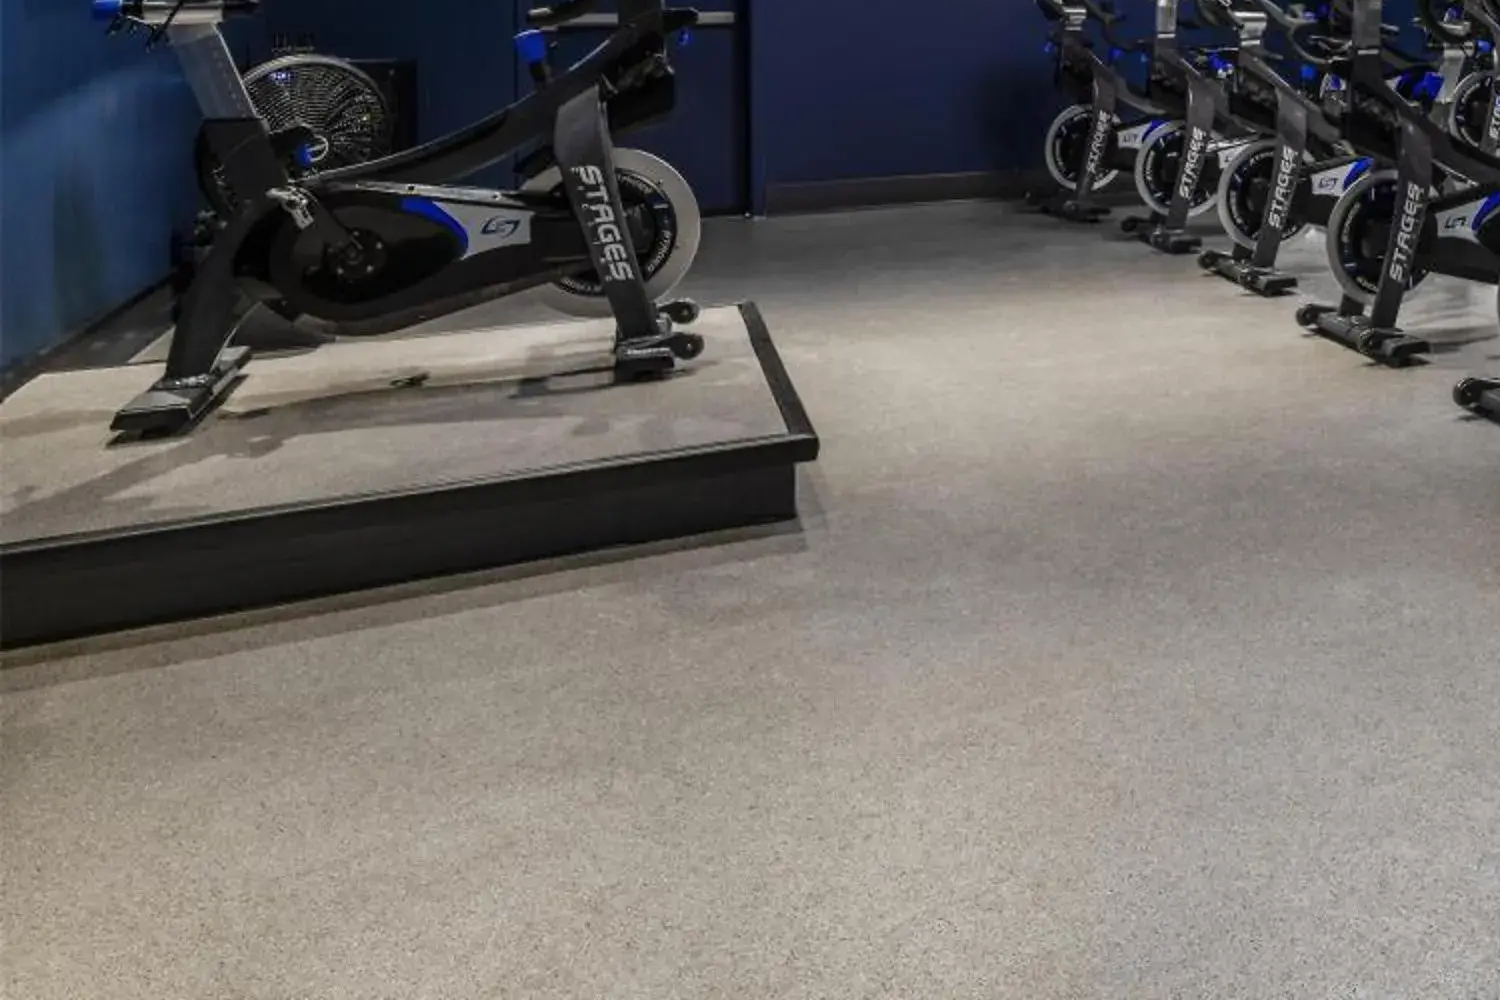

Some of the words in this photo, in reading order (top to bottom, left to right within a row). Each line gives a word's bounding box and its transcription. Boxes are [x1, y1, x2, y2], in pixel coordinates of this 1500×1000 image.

[576, 165, 635, 281] STAGES
[1268, 145, 1296, 229] STAGES
[1389, 181, 1420, 282] STAGES
